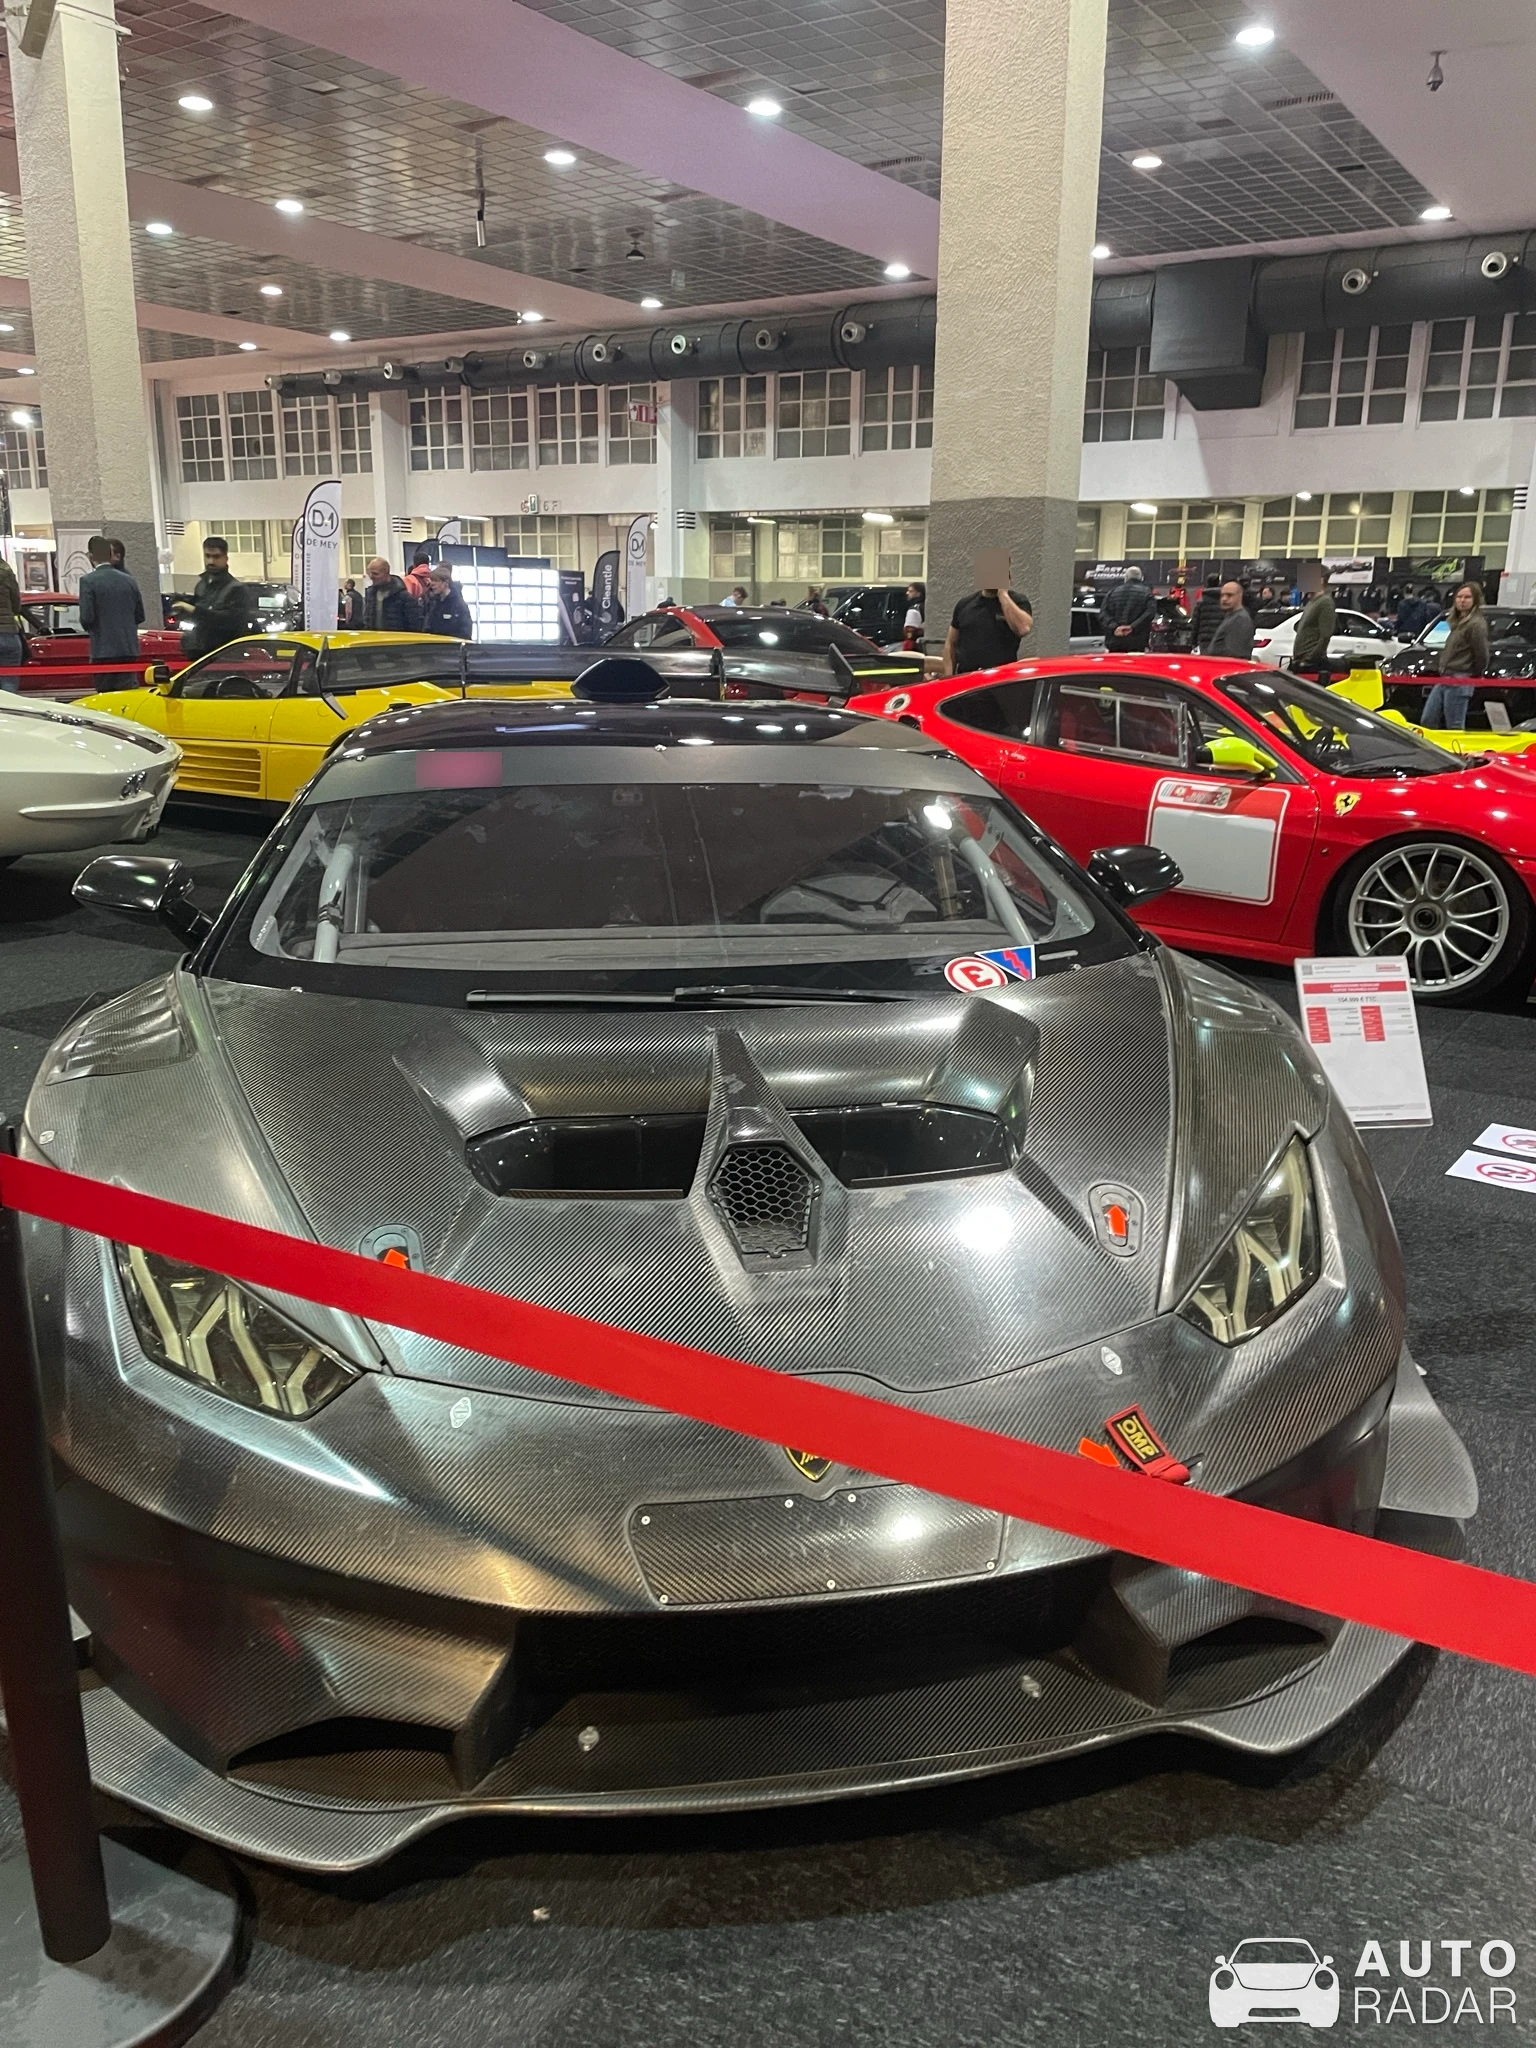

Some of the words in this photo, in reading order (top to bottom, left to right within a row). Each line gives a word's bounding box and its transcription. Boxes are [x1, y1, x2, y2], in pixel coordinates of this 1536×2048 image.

[306, 538, 317, 547] DE
[320, 540, 338, 549] MEY
[602, 564, 613, 609] Cleantle
[1122, 1418, 1156, 1456] OMP
